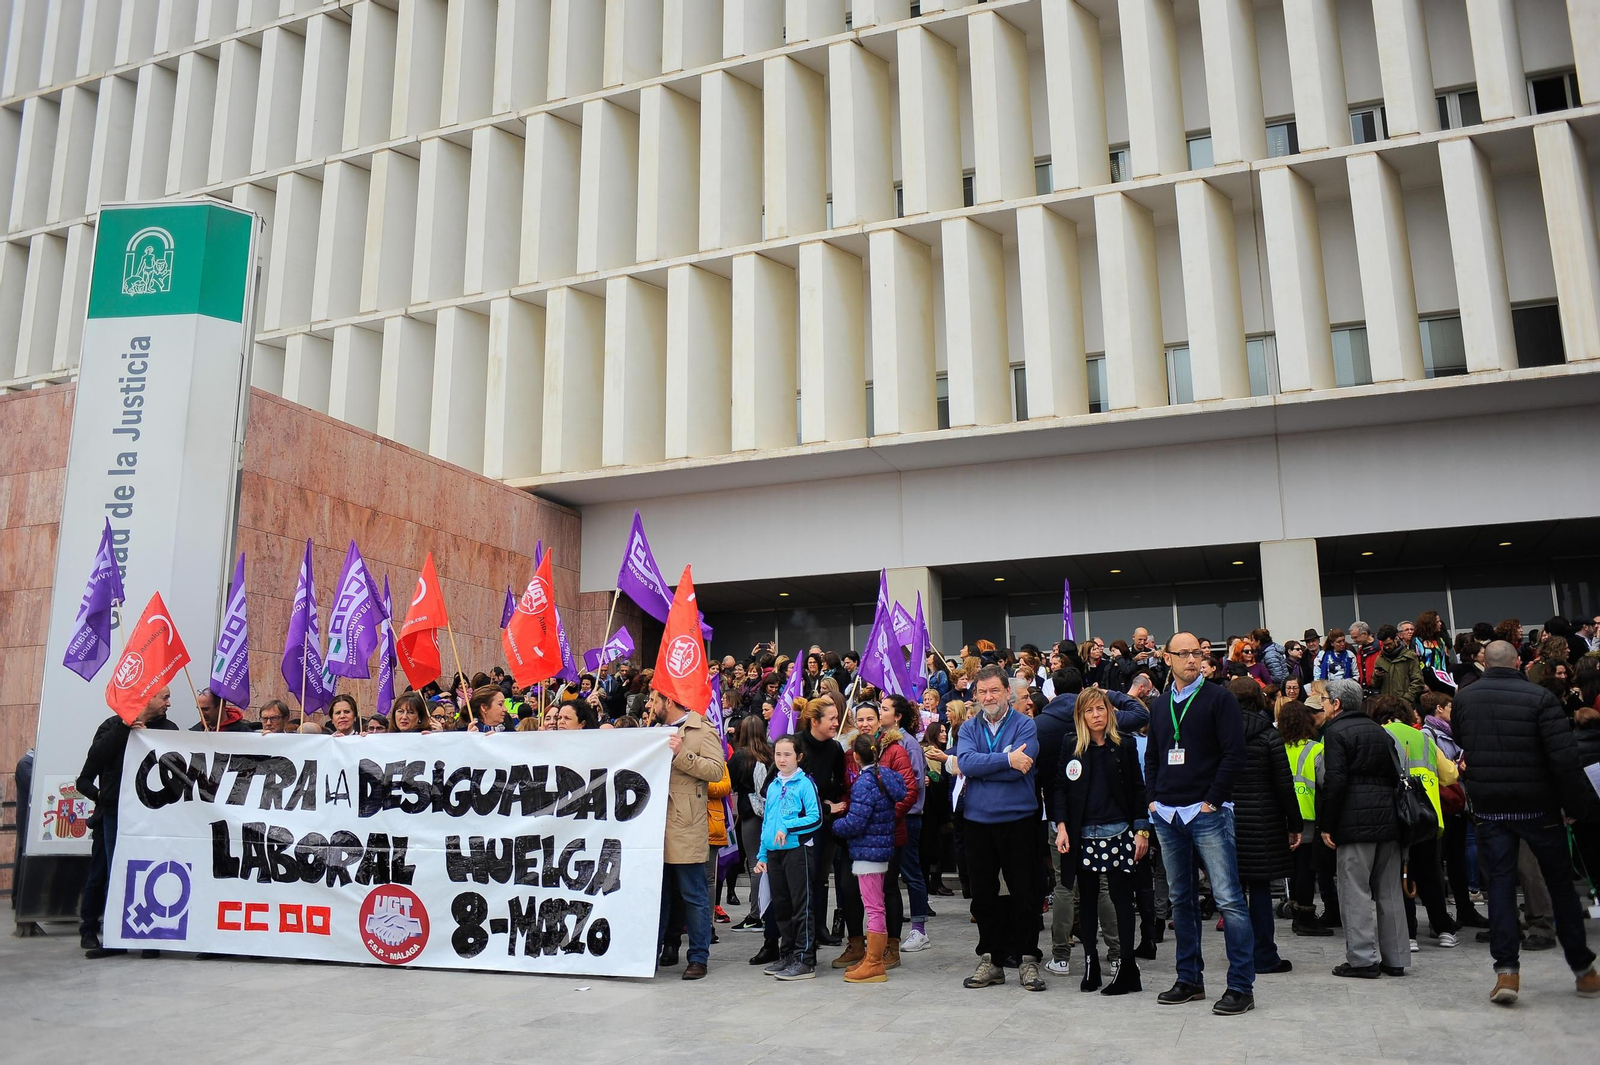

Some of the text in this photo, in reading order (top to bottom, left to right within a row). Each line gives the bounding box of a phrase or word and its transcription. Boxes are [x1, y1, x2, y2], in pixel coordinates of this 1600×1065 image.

[112, 335, 151, 442] Justicia
[107, 451, 138, 476] la
[105, 485, 136, 519] de
[526, 579, 549, 608] UGT
[115, 654, 137, 682] UGT
[668, 639, 689, 671] UGT
[135, 749, 318, 811] CONTRA
[325, 768, 352, 809] LA
[209, 819, 622, 896] LABORAL HUELGA
[373, 894, 414, 919] UGT
[367, 939, 384, 957] F.S.P.
[389, 943, 421, 960] MÁLAGA
